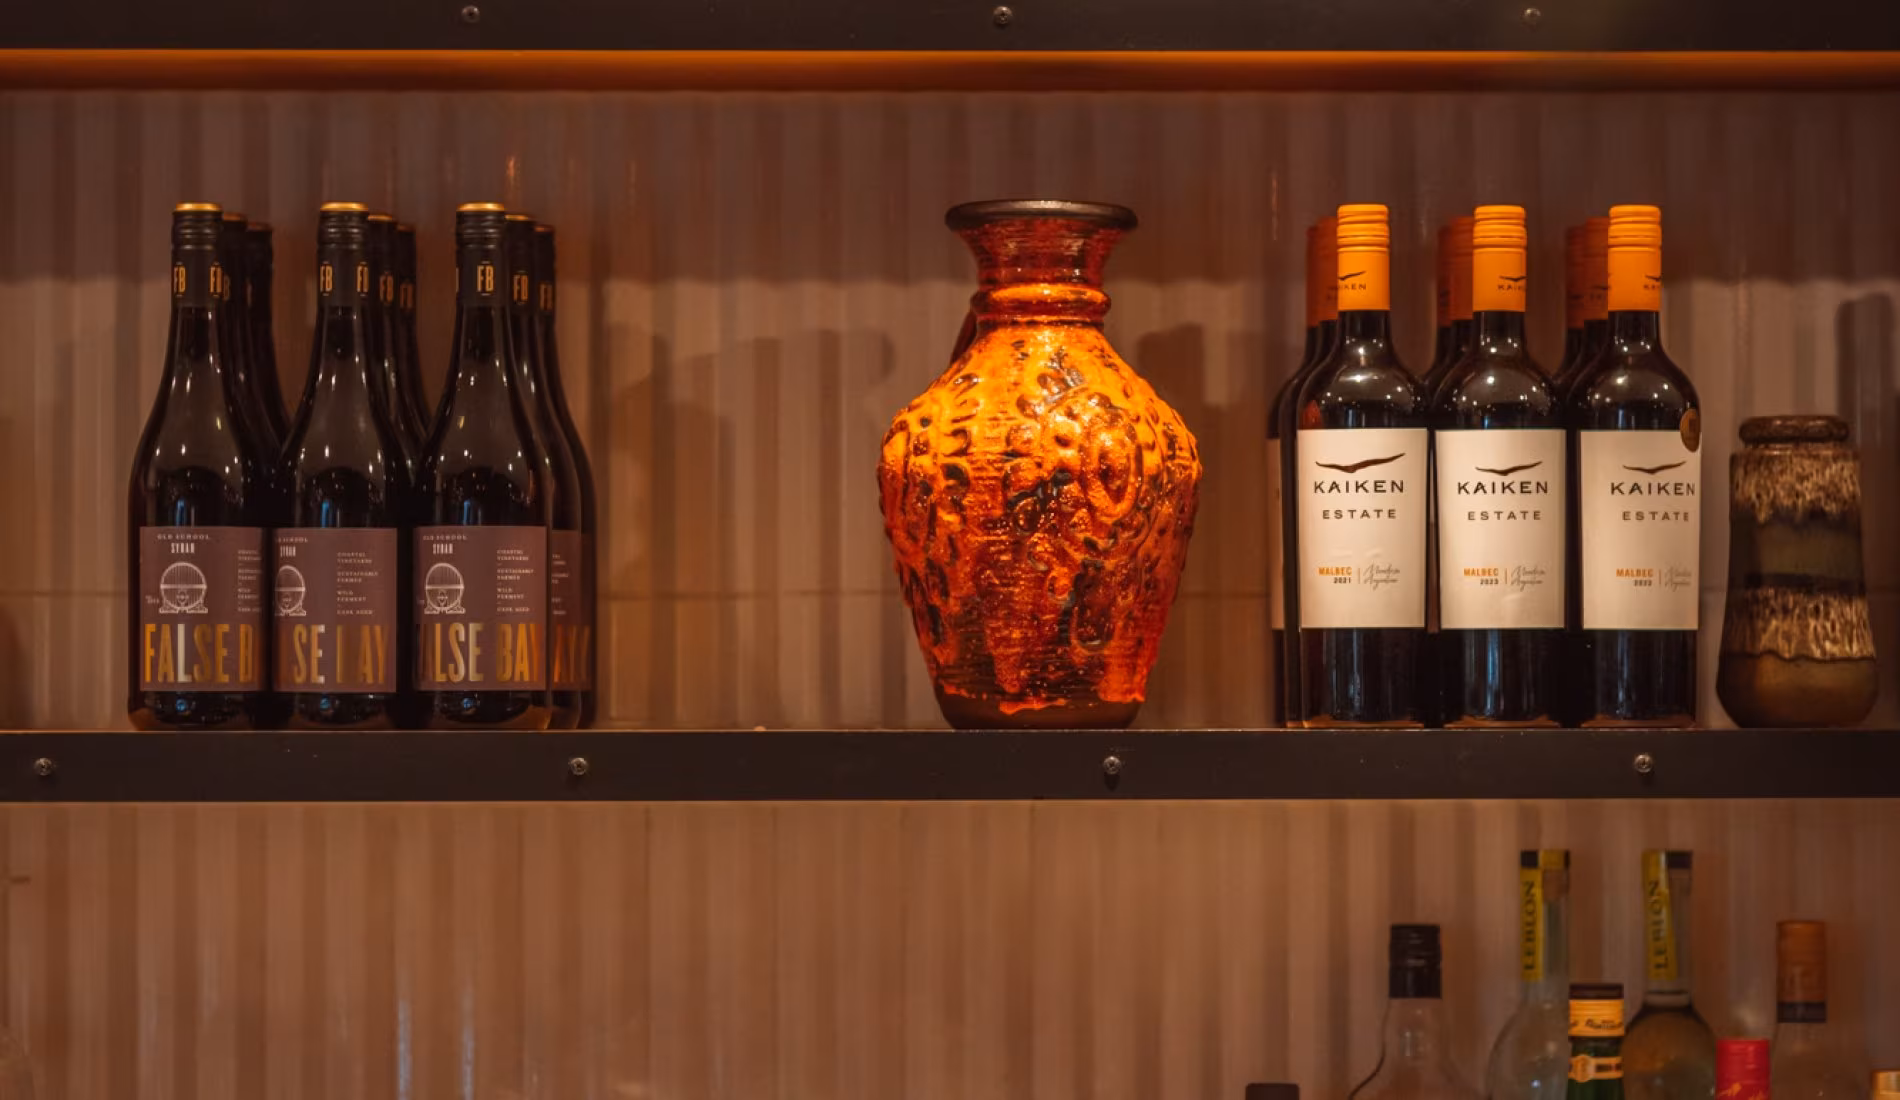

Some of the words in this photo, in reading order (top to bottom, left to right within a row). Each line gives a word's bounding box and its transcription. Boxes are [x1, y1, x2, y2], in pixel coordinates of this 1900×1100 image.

[174, 266, 186, 293] FB
[320, 265, 333, 293] FB
[477, 265, 493, 293] FB
[1314, 480, 1404, 494] KAIKEN
[1457, 481, 1549, 495] KAIKEN
[1610, 482, 1695, 496] KAIKEN
[1322, 509, 1397, 520] ESTATE
[1468, 511, 1542, 521] ESTATE
[1622, 511, 1689, 522] ESTATE
[1318, 567, 1352, 576] MALBEC
[1464, 567, 1498, 577] MALBEC
[1615, 568, 1653, 578] MALBEC
[144, 623, 231, 684] FALSE
